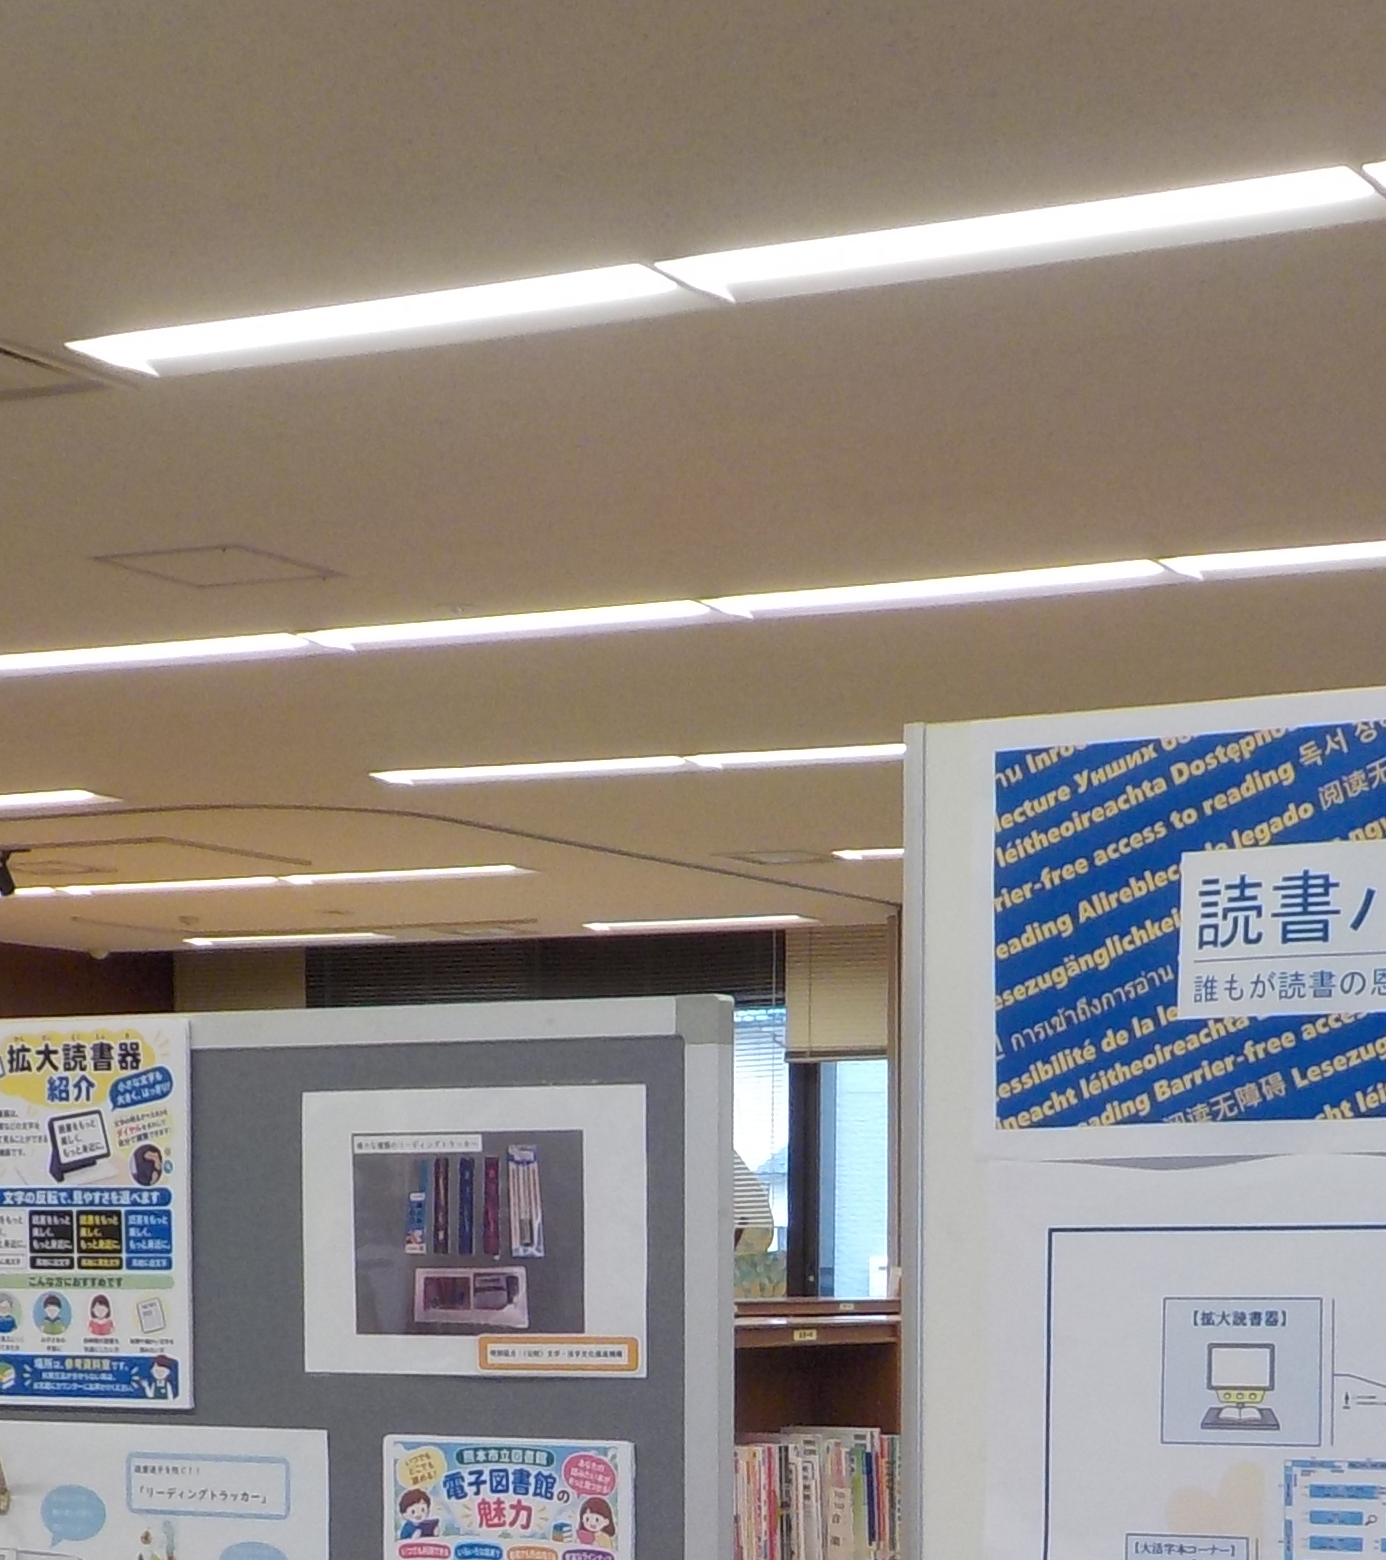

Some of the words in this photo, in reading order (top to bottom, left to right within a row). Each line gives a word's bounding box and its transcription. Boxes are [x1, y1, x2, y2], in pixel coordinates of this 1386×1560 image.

[1092, 819, 1168, 866] access
[1170, 807, 1198, 830] to
[1202, 763, 1295, 817] reading
[1299, 728, 1349, 766] 독서
[996, 773, 1168, 868] léitheoireachta
[1101, 1029, 1129, 1053] de
[1131, 1016, 1156, 1039] la
[7, 1041, 142, 1074] 拡大読書器
[1080, 1015, 1251, 1099] léitheoireachta
[1152, 1031, 1297, 1102] Barrier-free
[47, 1075, 96, 1102] 紹介
[2, 1190, 160, 1206] 文字の反転で、見やすさを選べます
[28, 1276, 124, 1287] こんな方におすすめです
[1191, 1308, 1291, 1329] 【拡大読書器】
[462, 1450, 549, 1467] 熊本市立図書館
[139, 1485, 268, 1505] 「リーディングトラッカー」
[443, 1467, 571, 1505] 電子図書館の
[476, 1497, 534, 1531] 魅力
